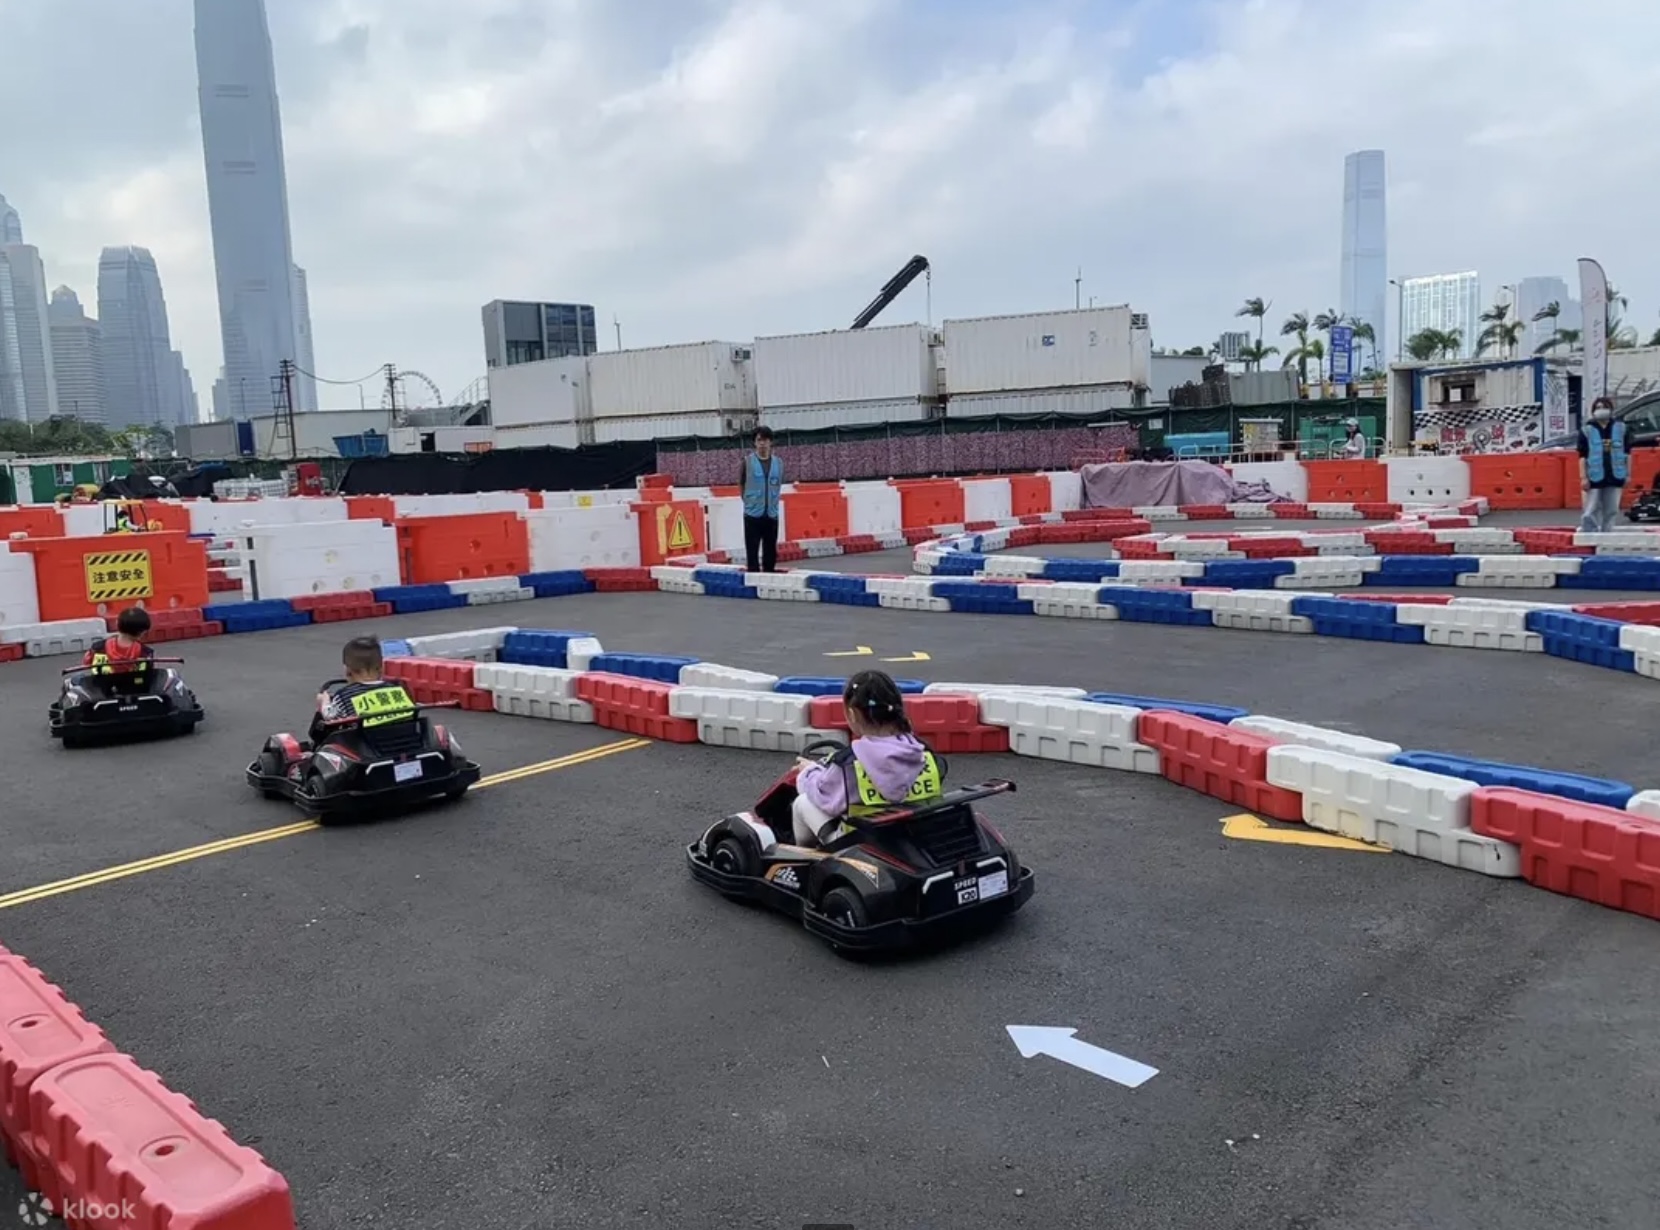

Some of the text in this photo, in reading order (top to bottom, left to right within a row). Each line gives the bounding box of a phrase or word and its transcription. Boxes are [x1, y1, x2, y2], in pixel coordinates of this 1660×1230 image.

[93, 568, 145, 584] 注意安全
[866, 779, 934, 802] PCE
